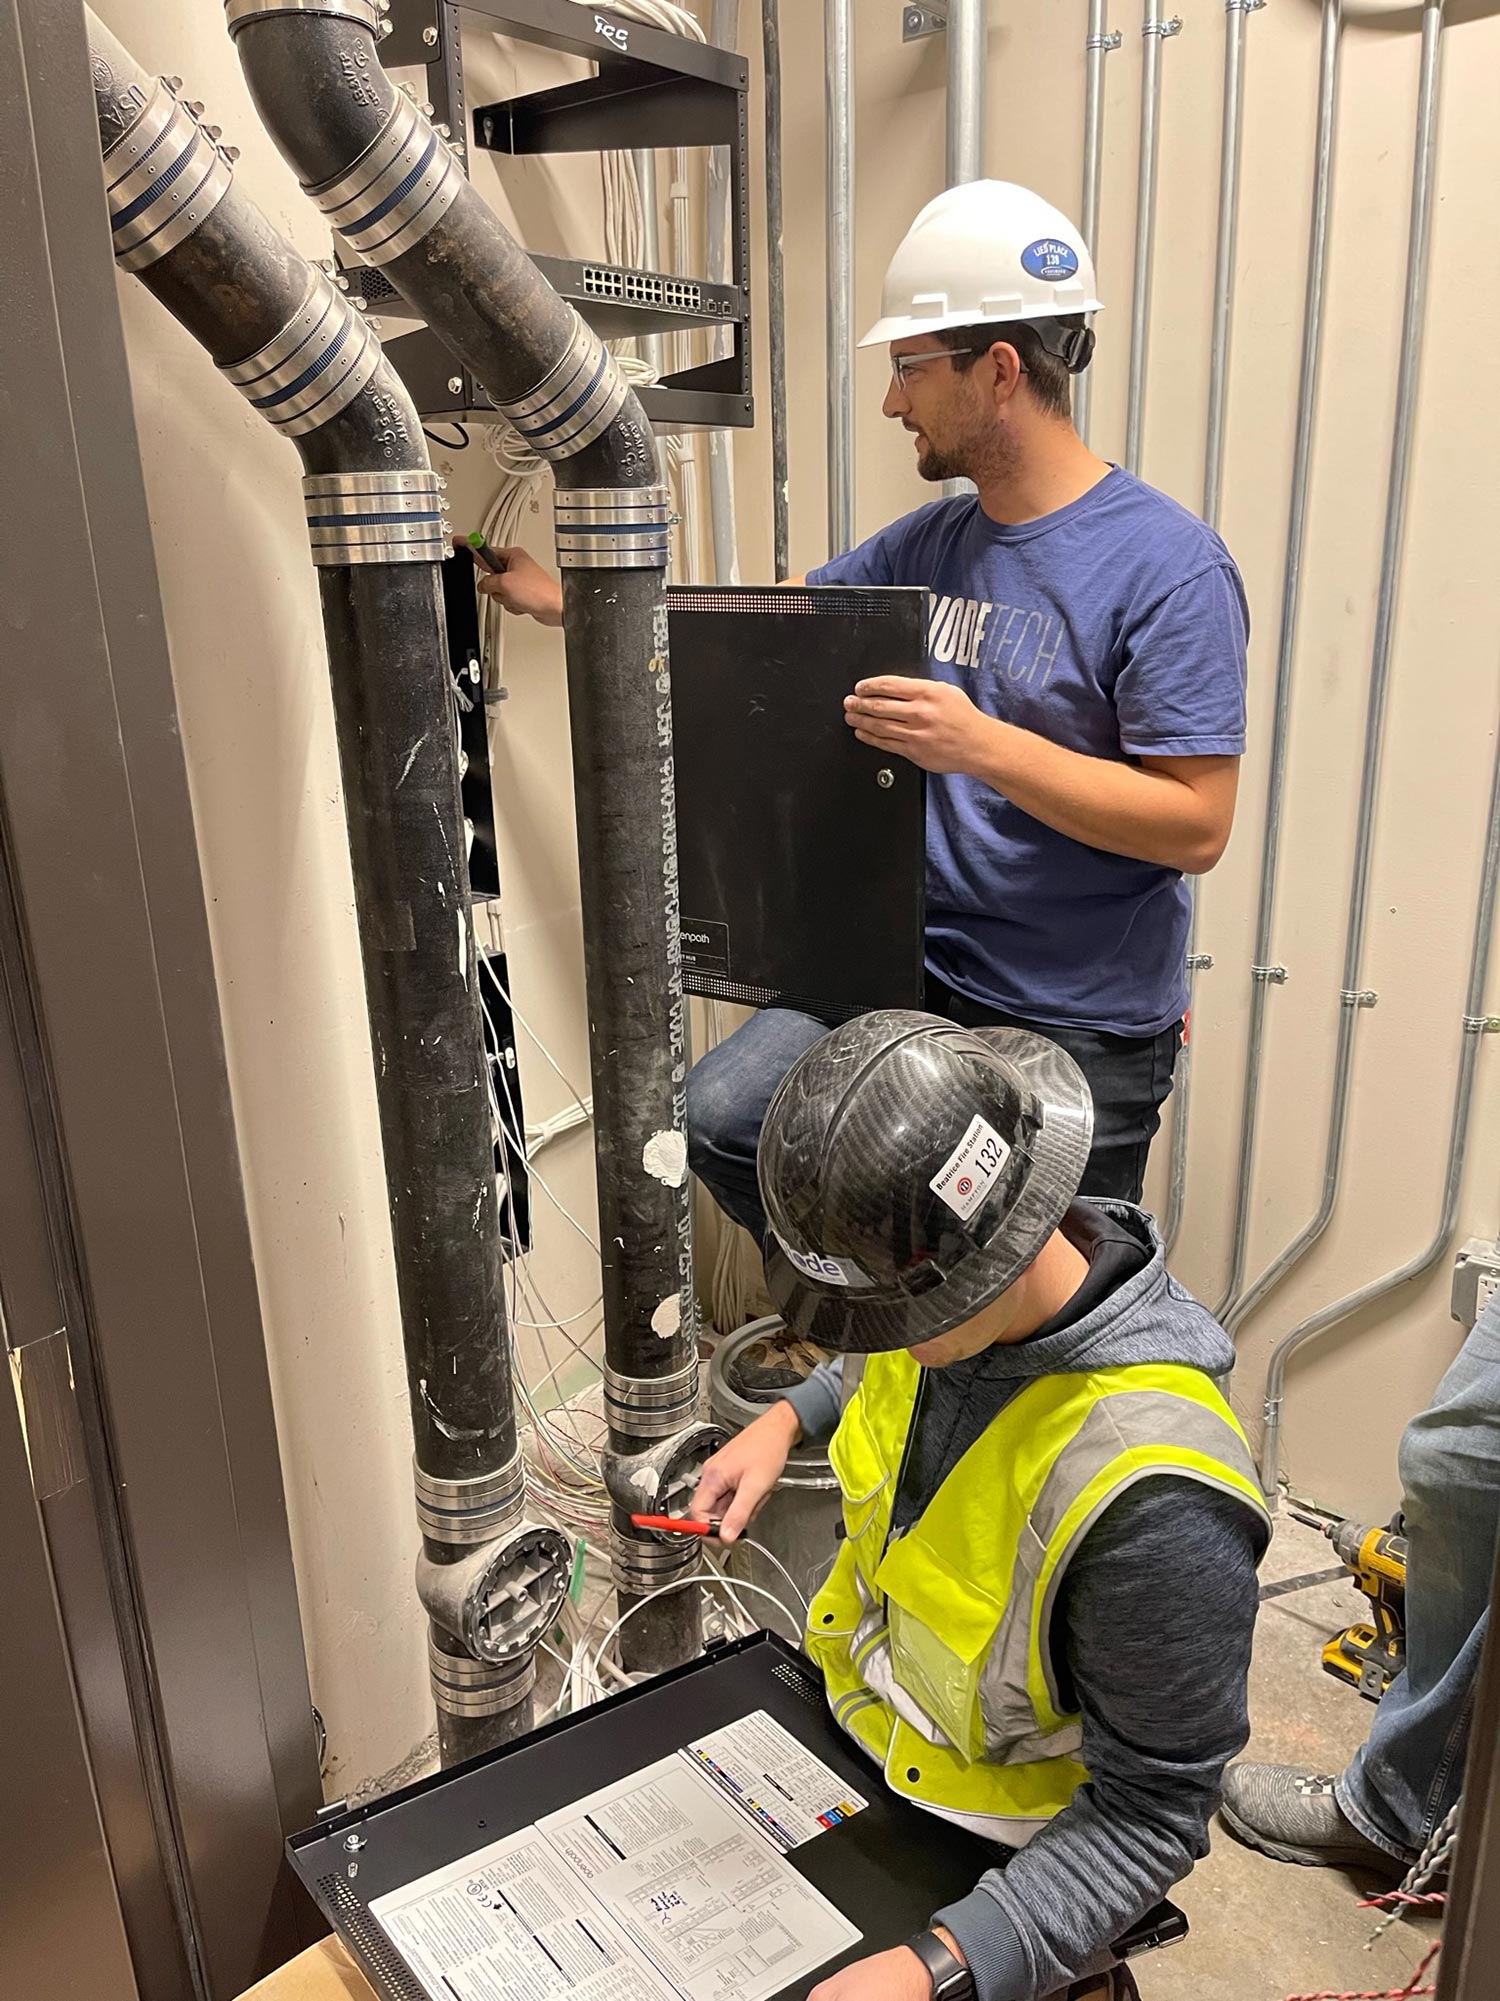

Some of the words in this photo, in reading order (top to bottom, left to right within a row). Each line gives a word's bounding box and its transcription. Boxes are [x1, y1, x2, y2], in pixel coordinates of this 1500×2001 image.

[680, 931, 710, 944] enpath
[936, 1162, 961, 1190] Beatrice
[958, 1147, 970, 1163] Fire
[967, 1123, 984, 1149] Station
[975, 1138, 1003, 1178] 132
[961, 1180, 985, 1211] HAMPTON
[565, 1847, 594, 1879] openpath
